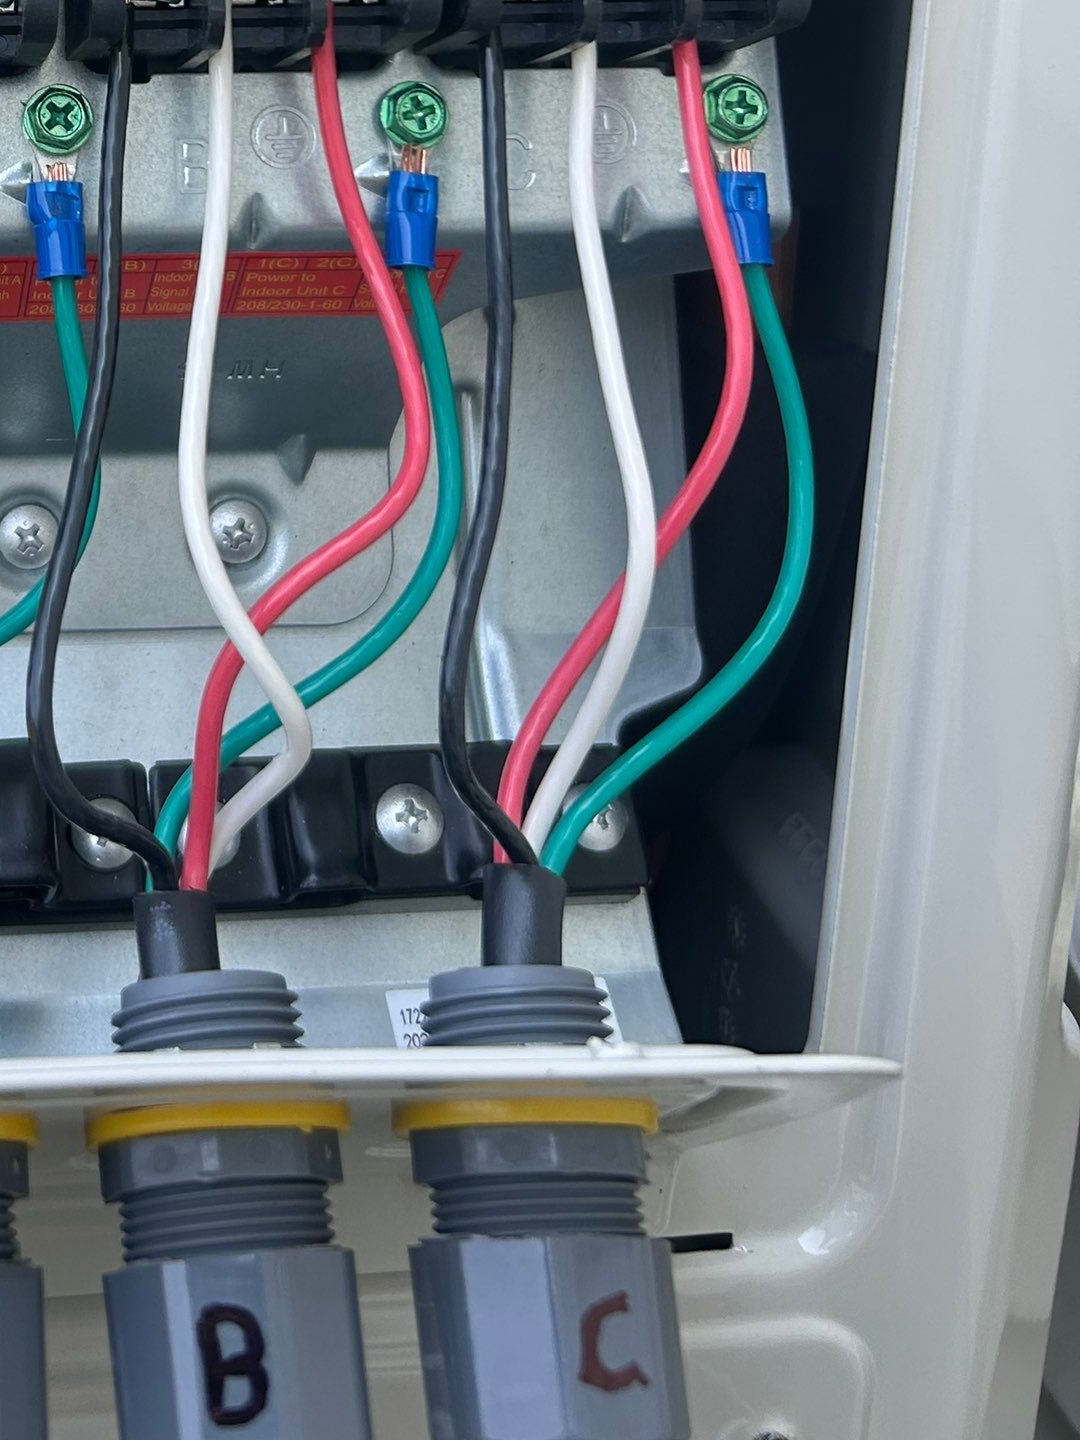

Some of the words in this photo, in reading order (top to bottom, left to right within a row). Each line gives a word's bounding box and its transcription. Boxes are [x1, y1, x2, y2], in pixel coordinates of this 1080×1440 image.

[259, 258, 300, 269] 1(C)
[316, 258, 360, 269] 2(C)
[11, 275, 22, 285] A
[154, 272, 195, 283] Indoor
[226, 271, 237, 281] B
[246, 273, 299, 283] Power
[301, 272, 316, 282] to
[124, 289, 136, 298] B
[150, 287, 189, 299] Signal
[241, 285, 292, 296] Indoor
[296, 285, 329, 296] Unit
[332, 285, 345, 295] C
[147, 301, 192, 313] Voltage
[237, 300, 343, 311] 208/230-1-60
[578, 1289, 649, 1393] C
[196, 1302, 269, 1426] B
